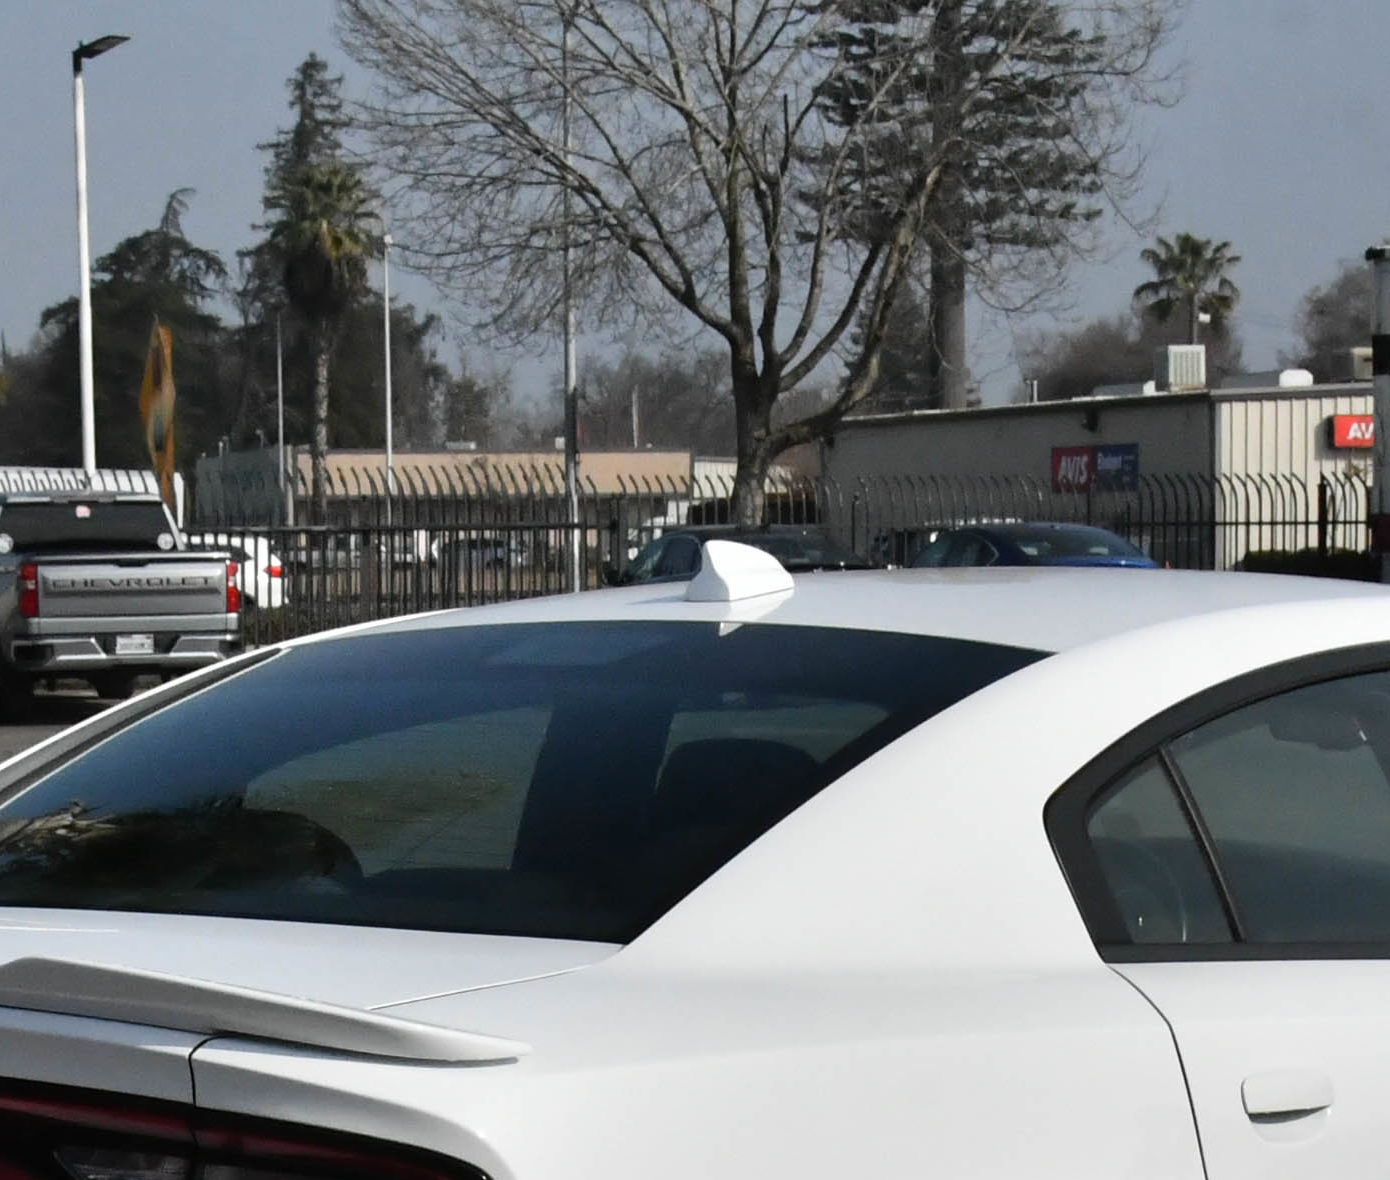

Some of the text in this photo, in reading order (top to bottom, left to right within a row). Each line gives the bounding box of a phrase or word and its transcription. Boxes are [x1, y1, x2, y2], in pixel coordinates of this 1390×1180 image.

[1346, 422, 1374, 440] AV
[1057, 454, 1088, 484] AVIS
[52, 576, 210, 588] CHEVROLET
